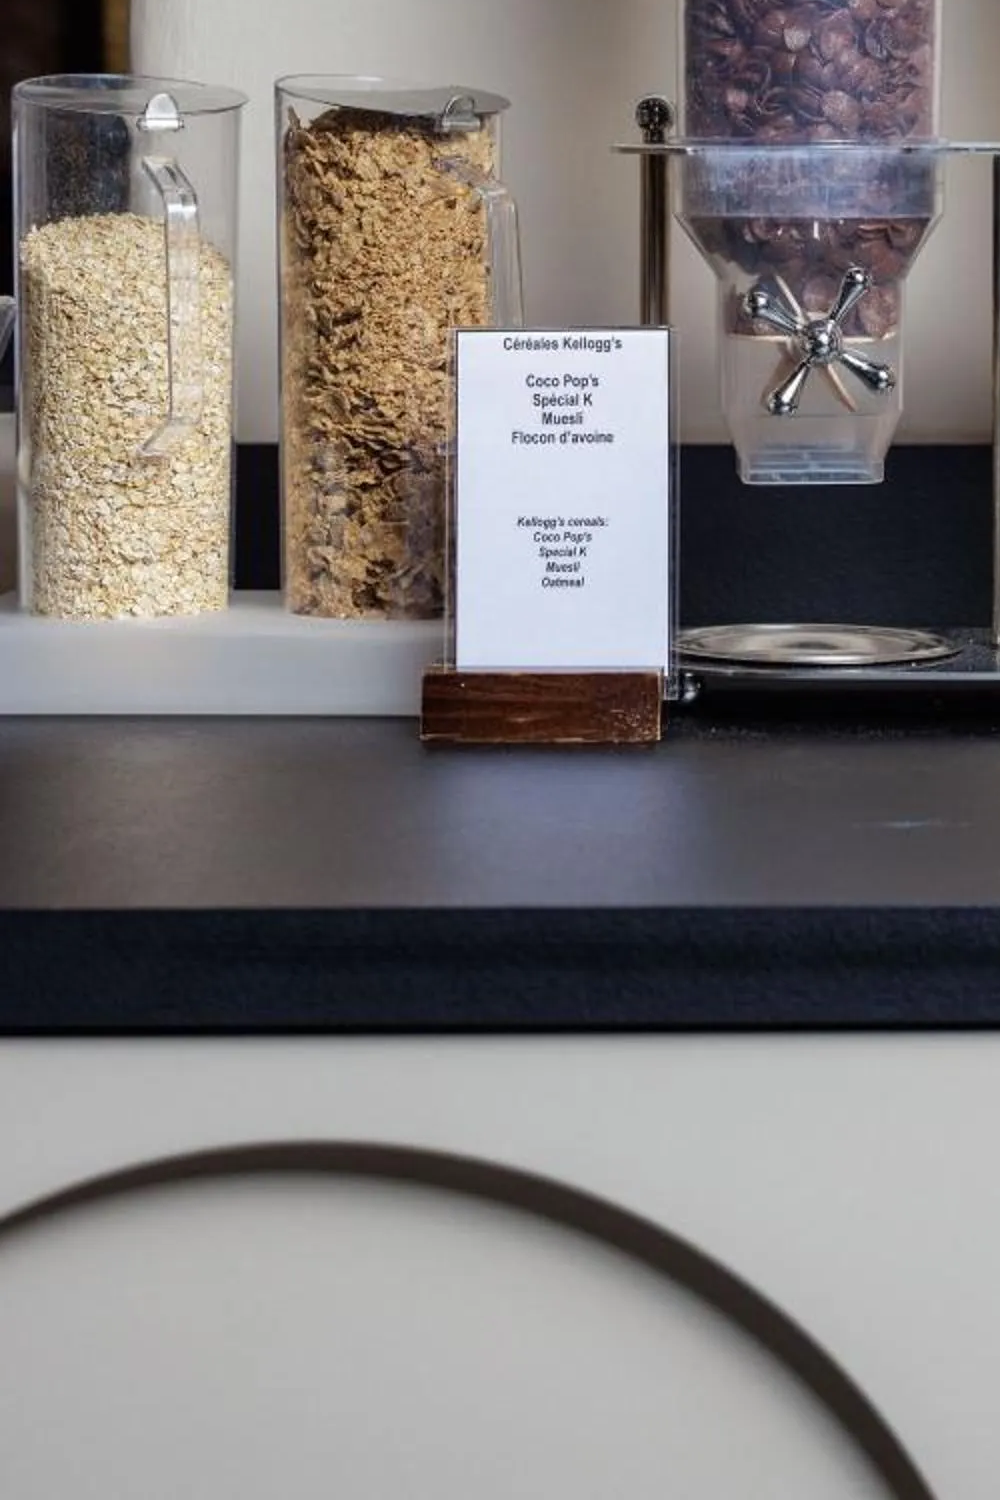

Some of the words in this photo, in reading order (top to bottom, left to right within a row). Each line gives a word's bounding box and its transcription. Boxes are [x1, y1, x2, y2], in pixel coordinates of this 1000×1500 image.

[503, 337, 559, 352] Céréales
[562, 336, 623, 353] Kellogg's
[525, 373, 560, 388] Coco
[563, 373, 599, 390] Pop's
[532, 393, 580, 410] Spécial
[583, 392, 593, 407] K
[542, 411, 584, 425] Muesli
[512, 431, 556, 445] Flocon
[559, 430, 614, 444] d'avoine
[517, 516, 565, 530] Kellogg's
[533, 531, 561, 543] Coco
[563, 531, 592, 544] Pop's
[579, 546, 587, 557] K
[541, 575, 584, 589] Oatmeal
